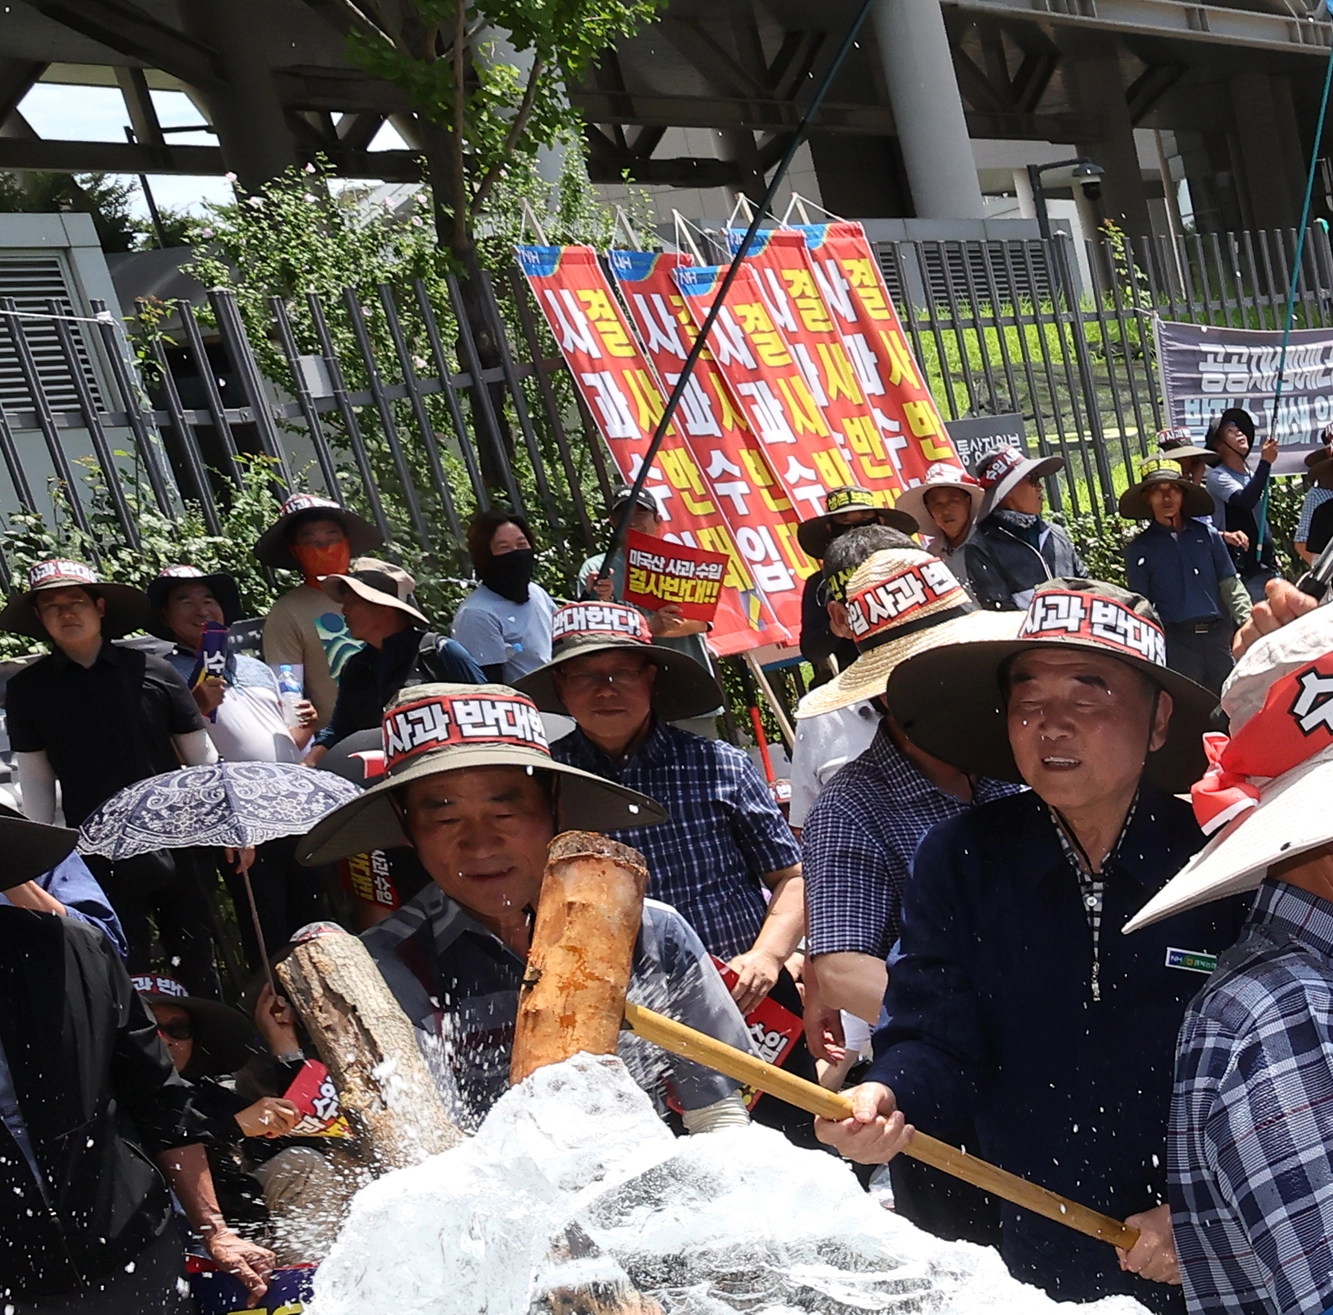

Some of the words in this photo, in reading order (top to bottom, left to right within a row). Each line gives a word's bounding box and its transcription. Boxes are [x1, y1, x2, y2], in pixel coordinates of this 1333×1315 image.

[628, 548, 665, 572] 미국산
[665, 560, 696, 578] 사과
[695, 562, 723, 579] 수입
[628, 566, 720, 605] 결사반대!!
[864, 571, 930, 624] 사과
[1028, 596, 1086, 639] 사과
[385, 703, 450, 758] 사과
